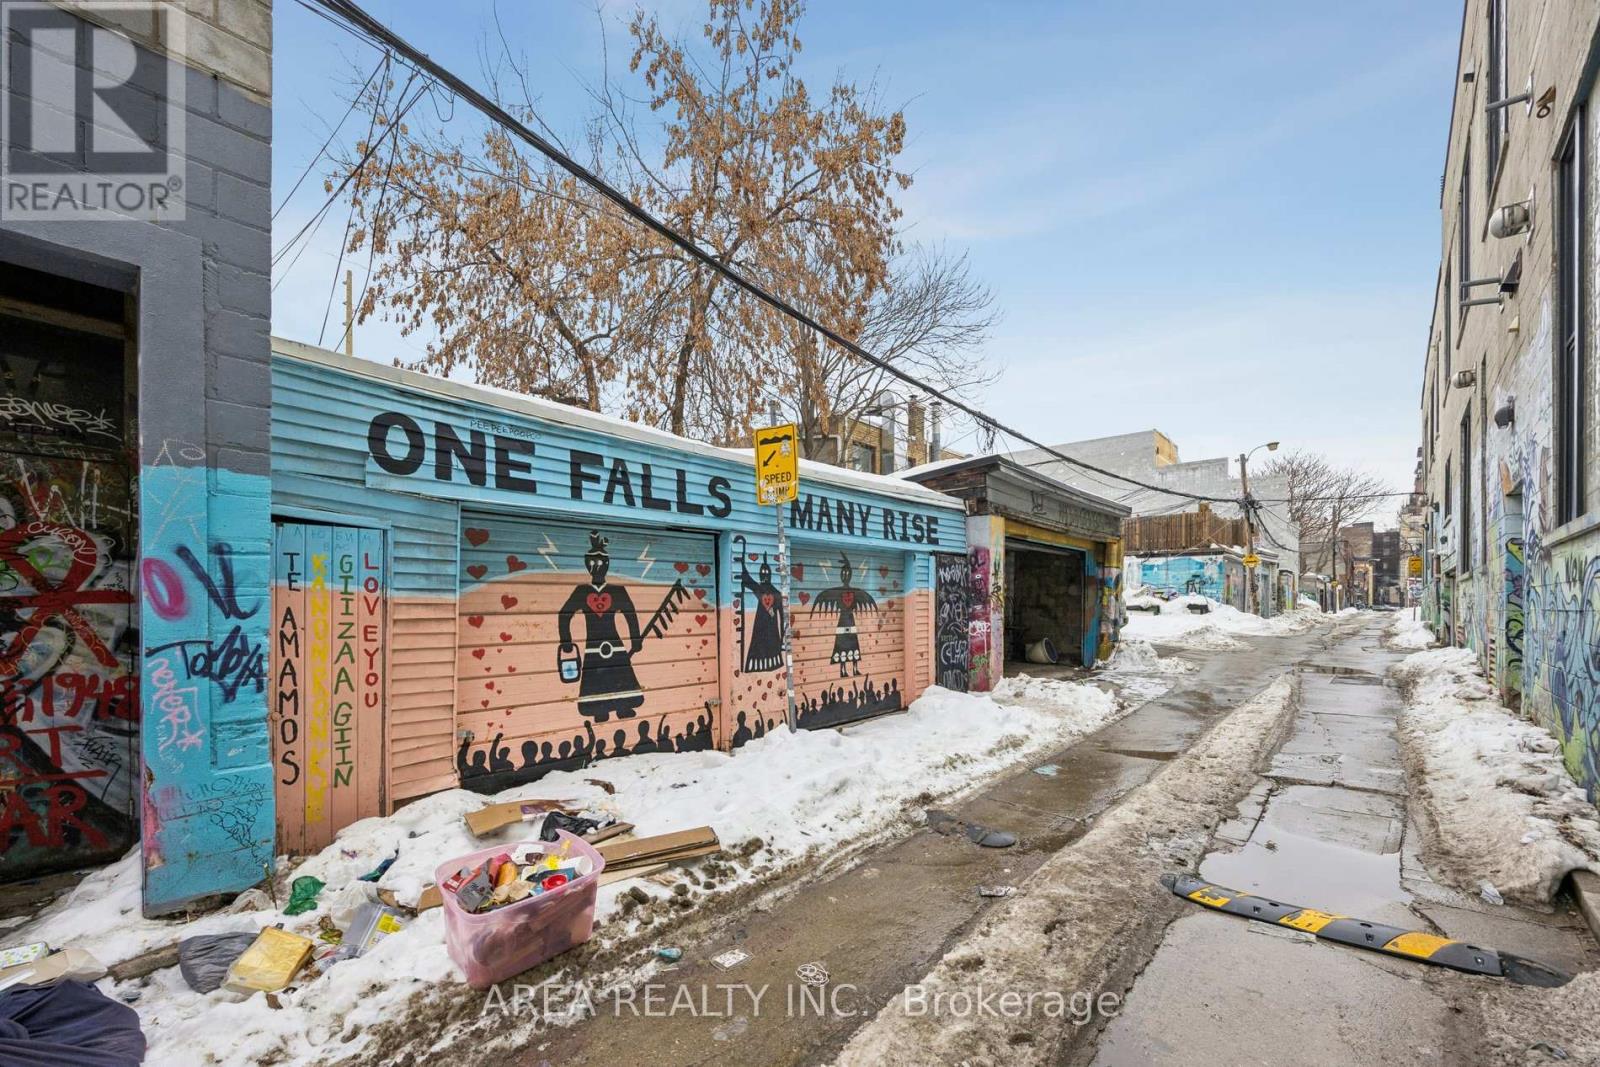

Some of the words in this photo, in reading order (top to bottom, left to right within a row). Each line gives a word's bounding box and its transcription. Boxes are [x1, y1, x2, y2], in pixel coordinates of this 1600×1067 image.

[367, 411, 537, 493] ONE
[569, 449, 732, 518] FALLS
[790, 493, 872, 537] MANY
[883, 508, 939, 545] RISE
[764, 471, 791, 485] SPEED
[283, 552, 301, 592] TE
[279, 606, 300, 786] AMAMOS
